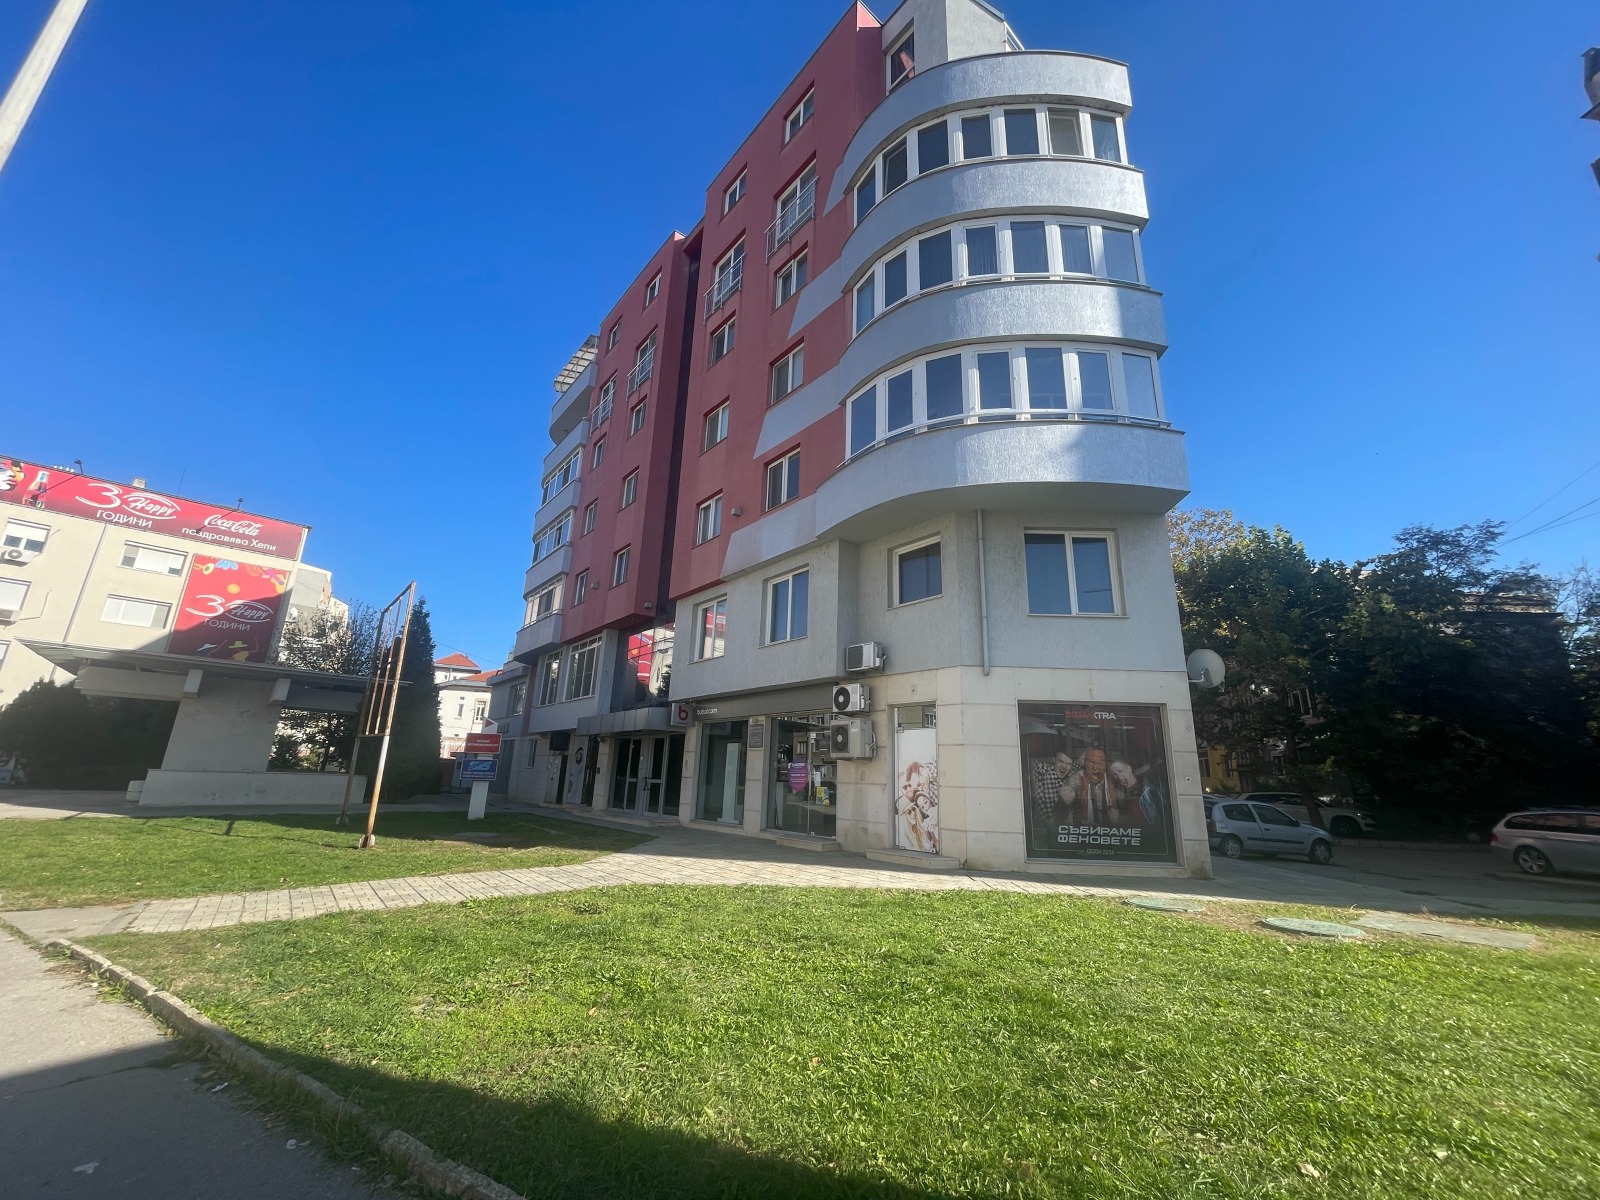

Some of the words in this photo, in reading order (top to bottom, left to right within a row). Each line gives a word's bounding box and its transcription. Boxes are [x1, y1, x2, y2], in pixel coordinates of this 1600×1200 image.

[128, 497, 175, 516] Happy
[96, 510, 152, 528] ГОДИНИ
[250, 539, 277, 551] Хепи
[228, 604, 270, 619] Happy
[203, 618, 250, 631] ГОДИНИ
[1058, 825, 1142, 836] СЪБИРАМЕ
[1057, 834, 1141, 846] ФЕНОВЕТЕ
